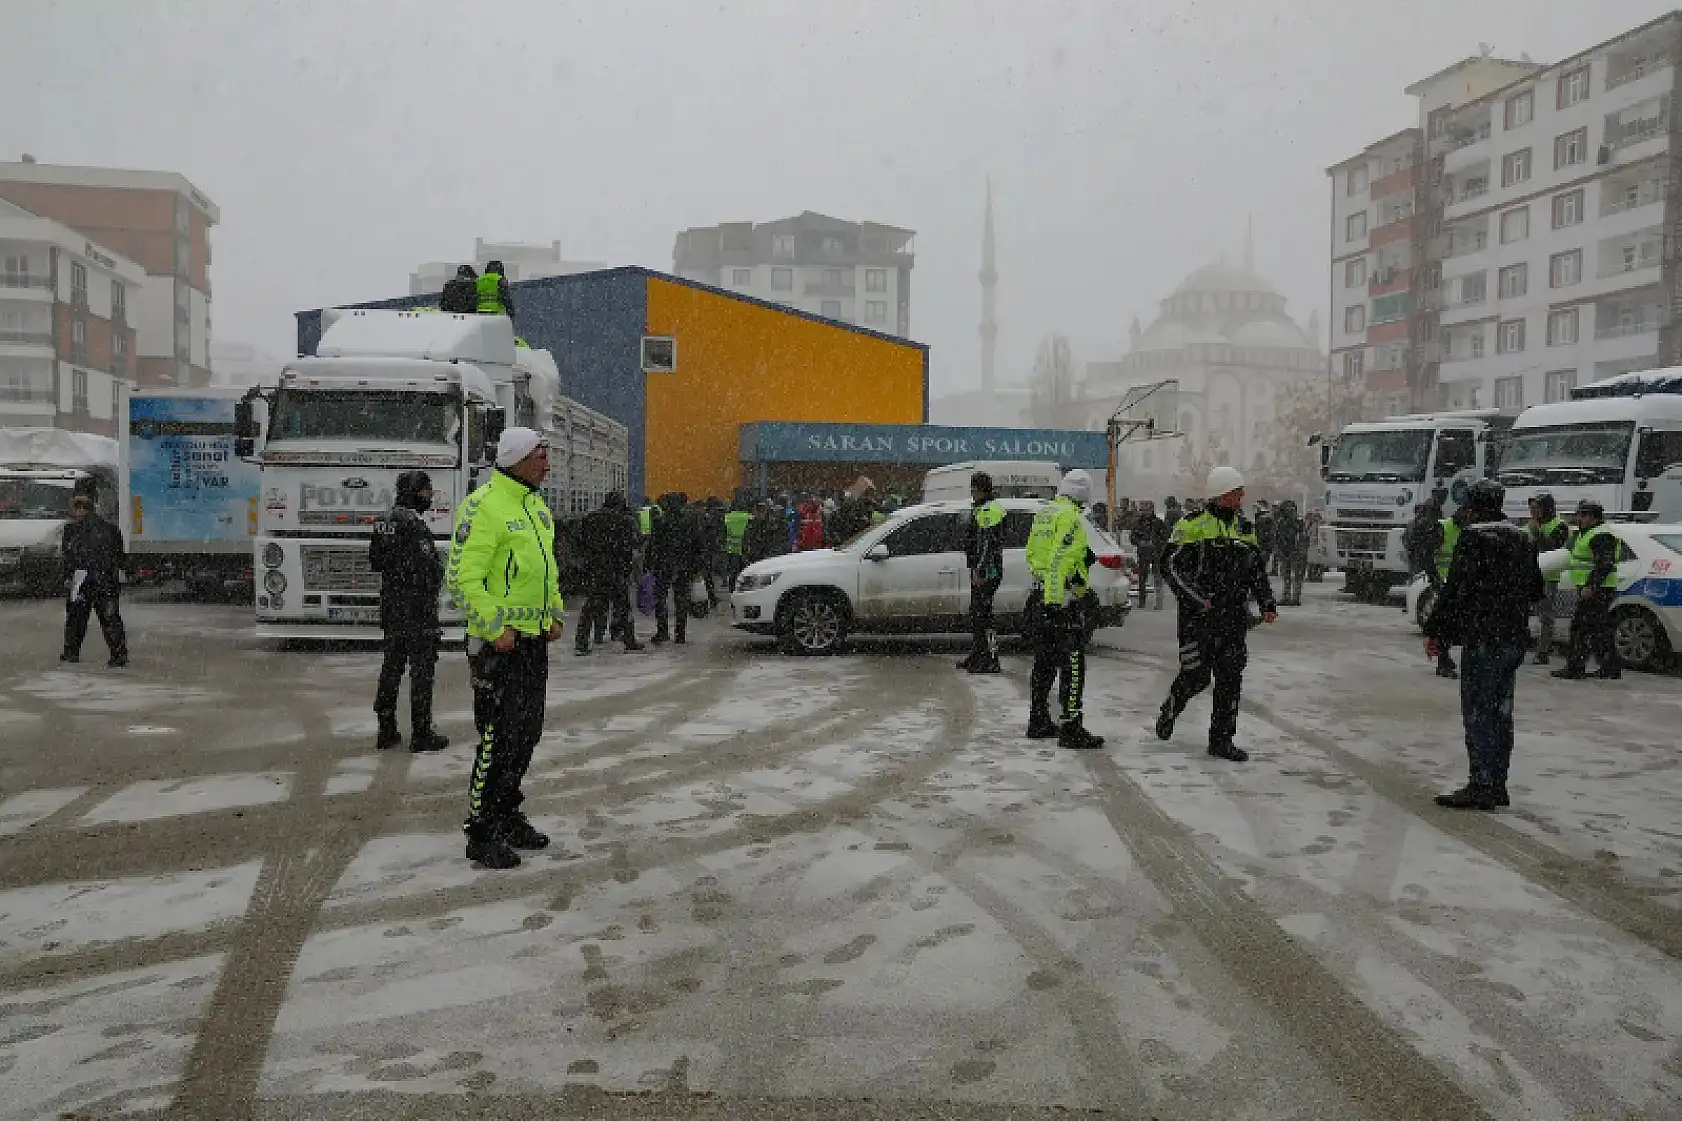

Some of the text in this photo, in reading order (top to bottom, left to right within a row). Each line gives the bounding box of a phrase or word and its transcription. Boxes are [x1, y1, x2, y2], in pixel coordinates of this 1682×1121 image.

[808, 434, 1076, 457] SARAN SPOR SALONU
